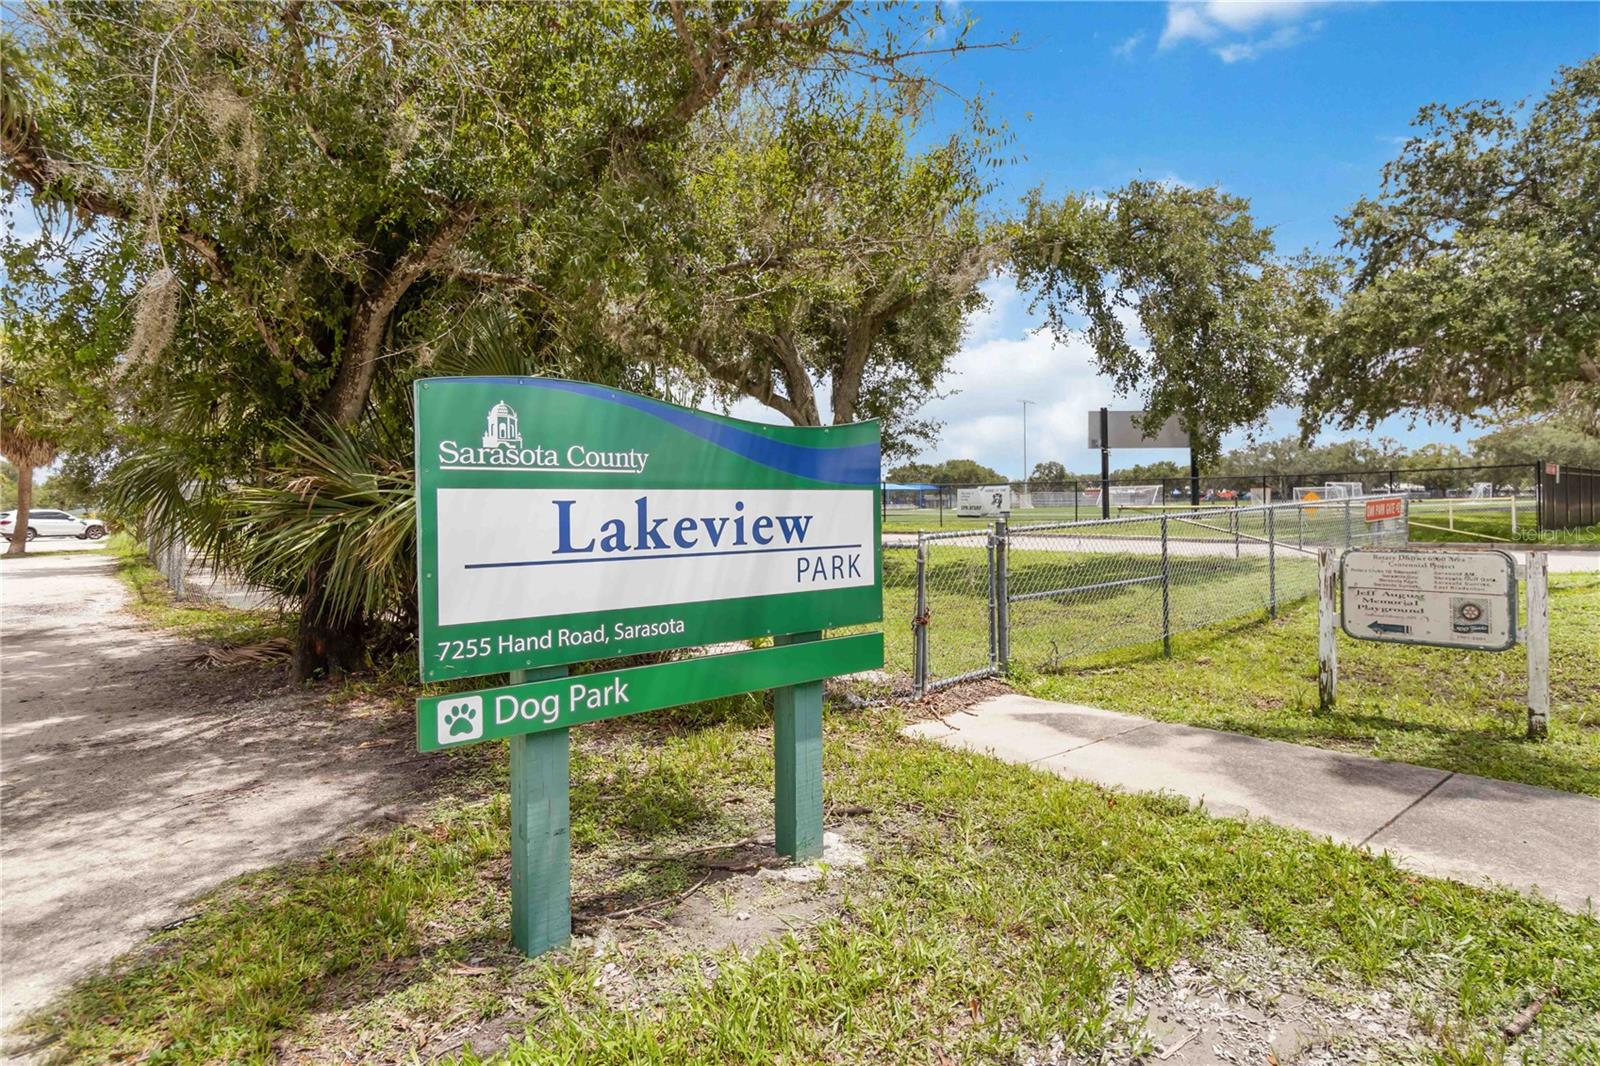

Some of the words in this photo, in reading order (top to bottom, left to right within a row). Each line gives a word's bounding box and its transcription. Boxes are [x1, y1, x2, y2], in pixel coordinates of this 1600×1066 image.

[438, 440, 559, 466] Sarasota
[566, 445, 650, 474] County
[551, 495, 814, 554] Lakeview
[796, 553, 862, 584] PARK
[1356, 589, 1375, 597] Jeff
[1357, 604, 1424, 614] Playground
[1362, 597, 1418, 606] Memorial
[437, 637, 492, 662] 7255
[498, 629, 552, 655] Hand
[558, 624, 610, 648] Road,
[614, 618, 685, 641] Sarasota
[495, 694, 560, 725] Dog
[570, 676, 630, 712] Park
